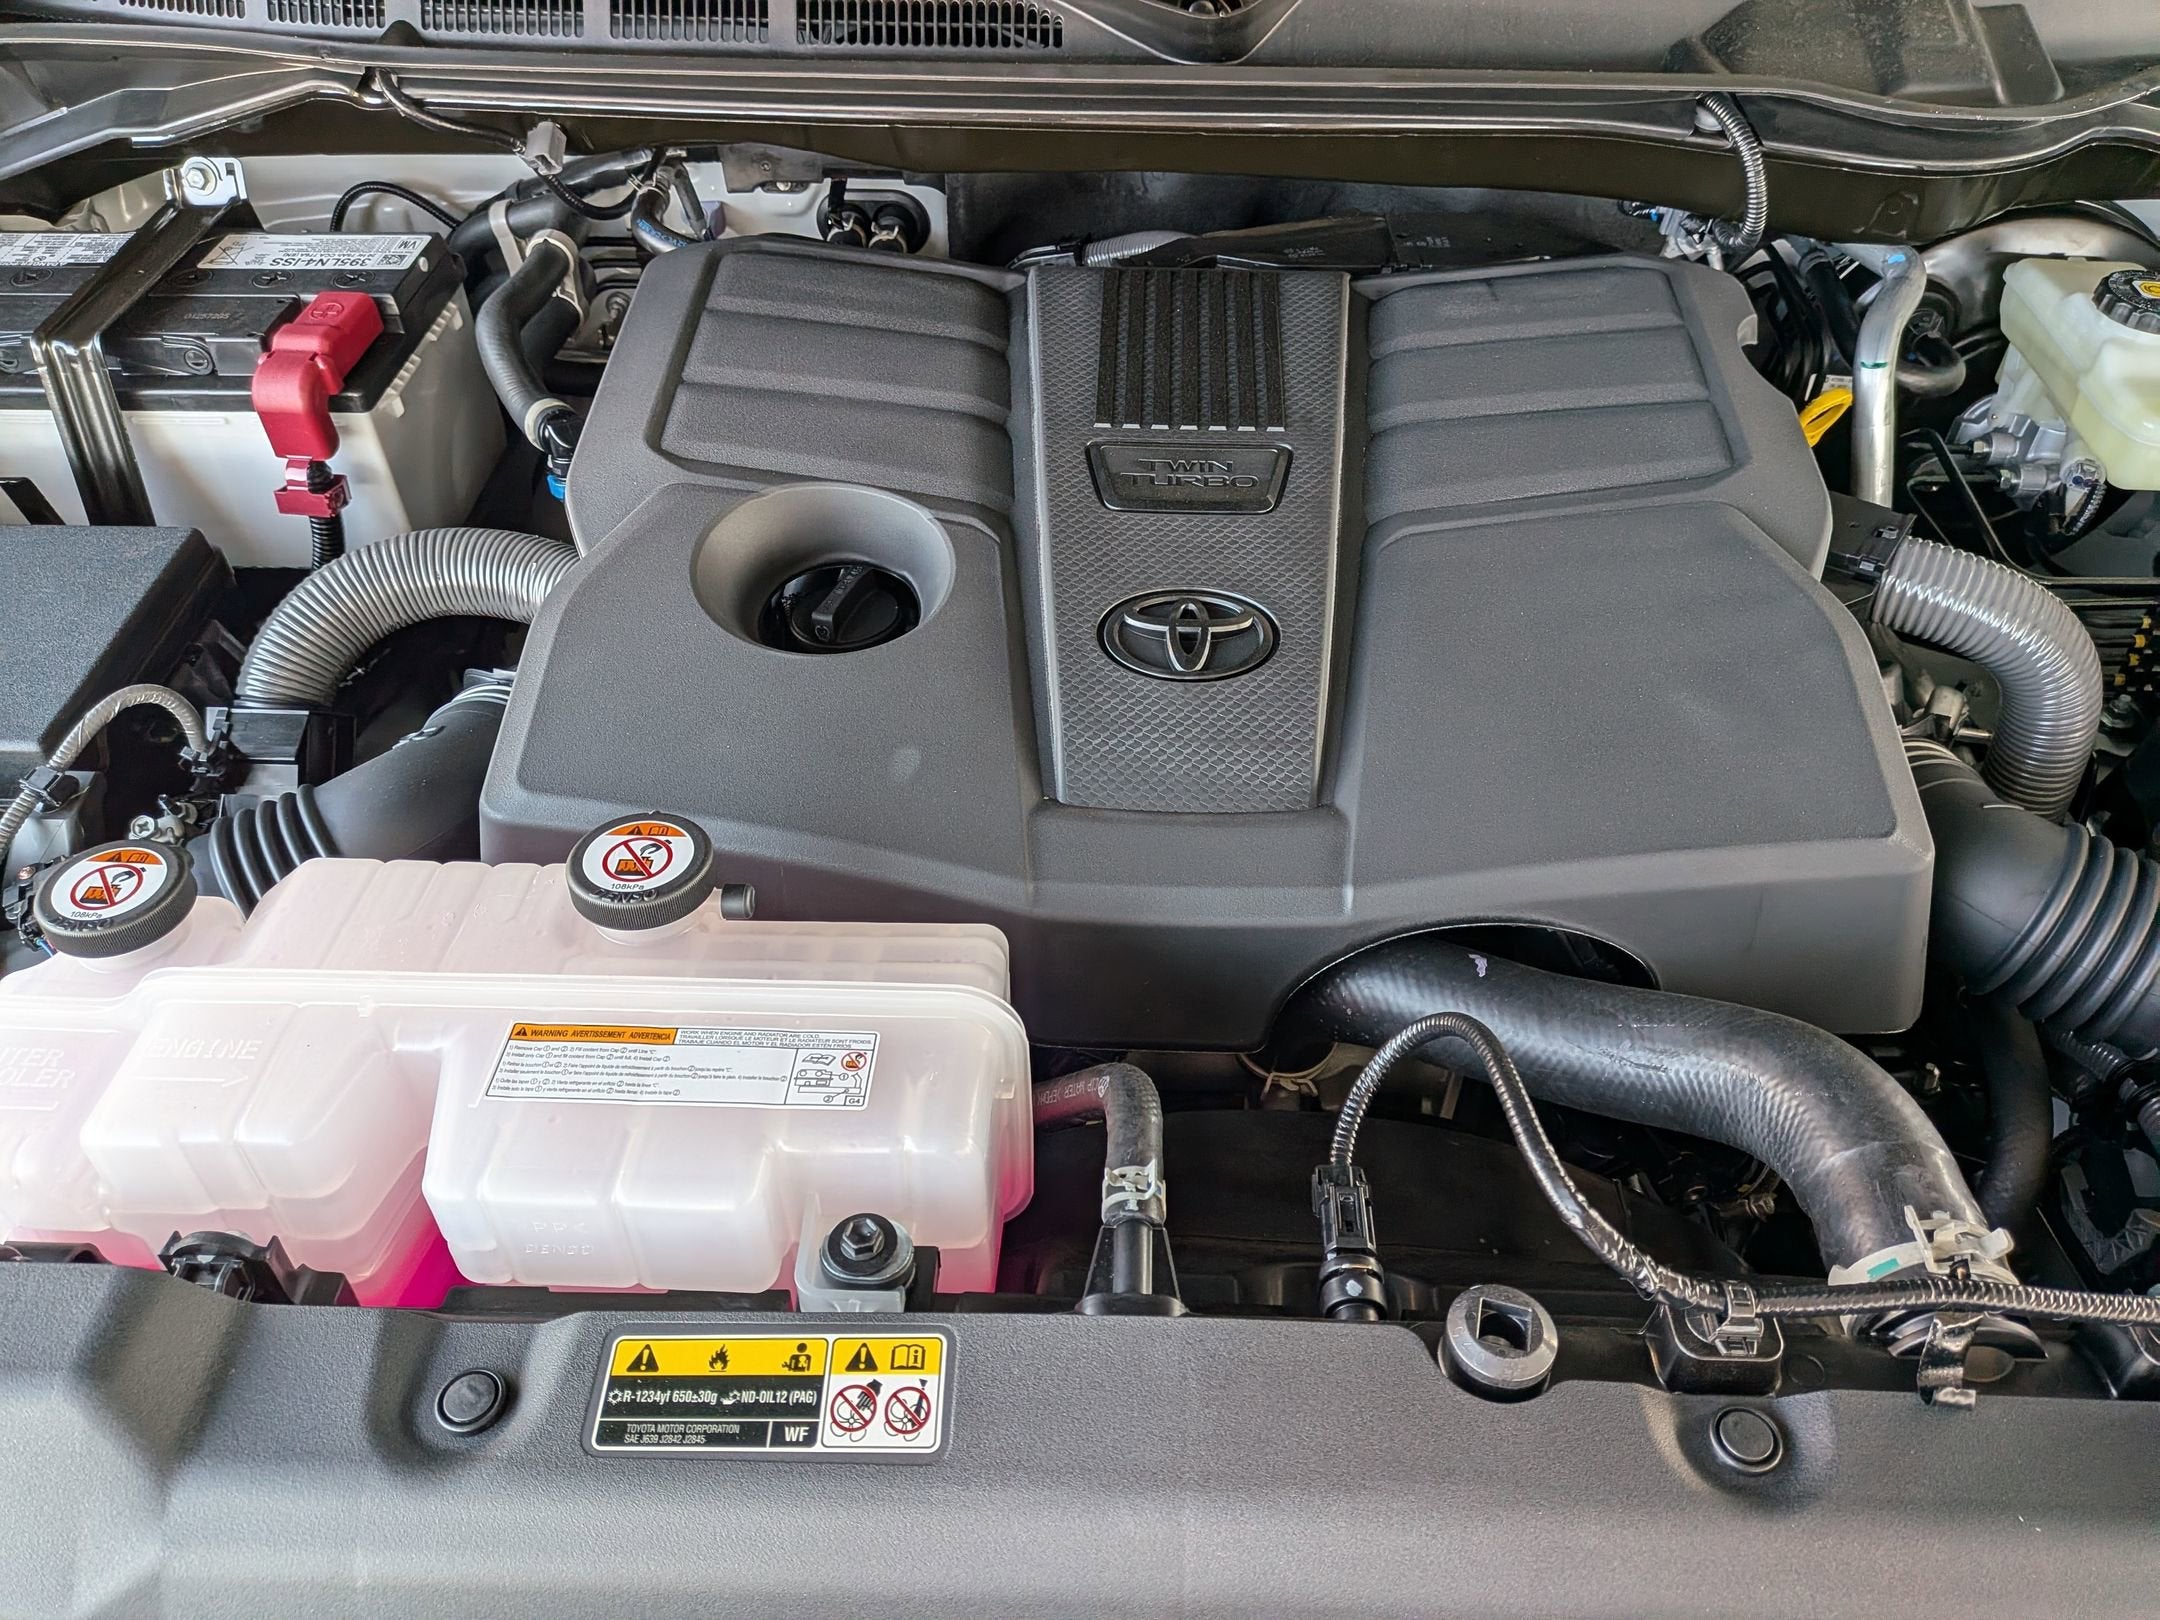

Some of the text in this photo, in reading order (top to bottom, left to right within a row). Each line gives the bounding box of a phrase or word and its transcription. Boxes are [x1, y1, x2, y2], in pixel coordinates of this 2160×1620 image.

[398, 240, 416, 248] VM
[270, 258, 372, 266] 395LN4-ISS
[1138, 459, 1233, 472] TWIN
[1120, 472, 1259, 487] TURBO
[588, 889, 658, 903] DENSO
[48, 916, 114, 932] DENSO
[530, 1029, 671, 1040] WARNING AVERTISSEMENT ADVERTENCIA
[146, 1038, 262, 1060] ENGINE
[525, 1242, 594, 1256] DENSO
[622, 1390, 817, 1406] R-1234yf 650±30g ND-OIL12 (PAG)
[627, 1424, 740, 1433] TOYOTA MOTOR CORPORATION
[784, 1426, 810, 1442] WF
[624, 1434, 706, 1444] SAE J639 J2842 J2845
